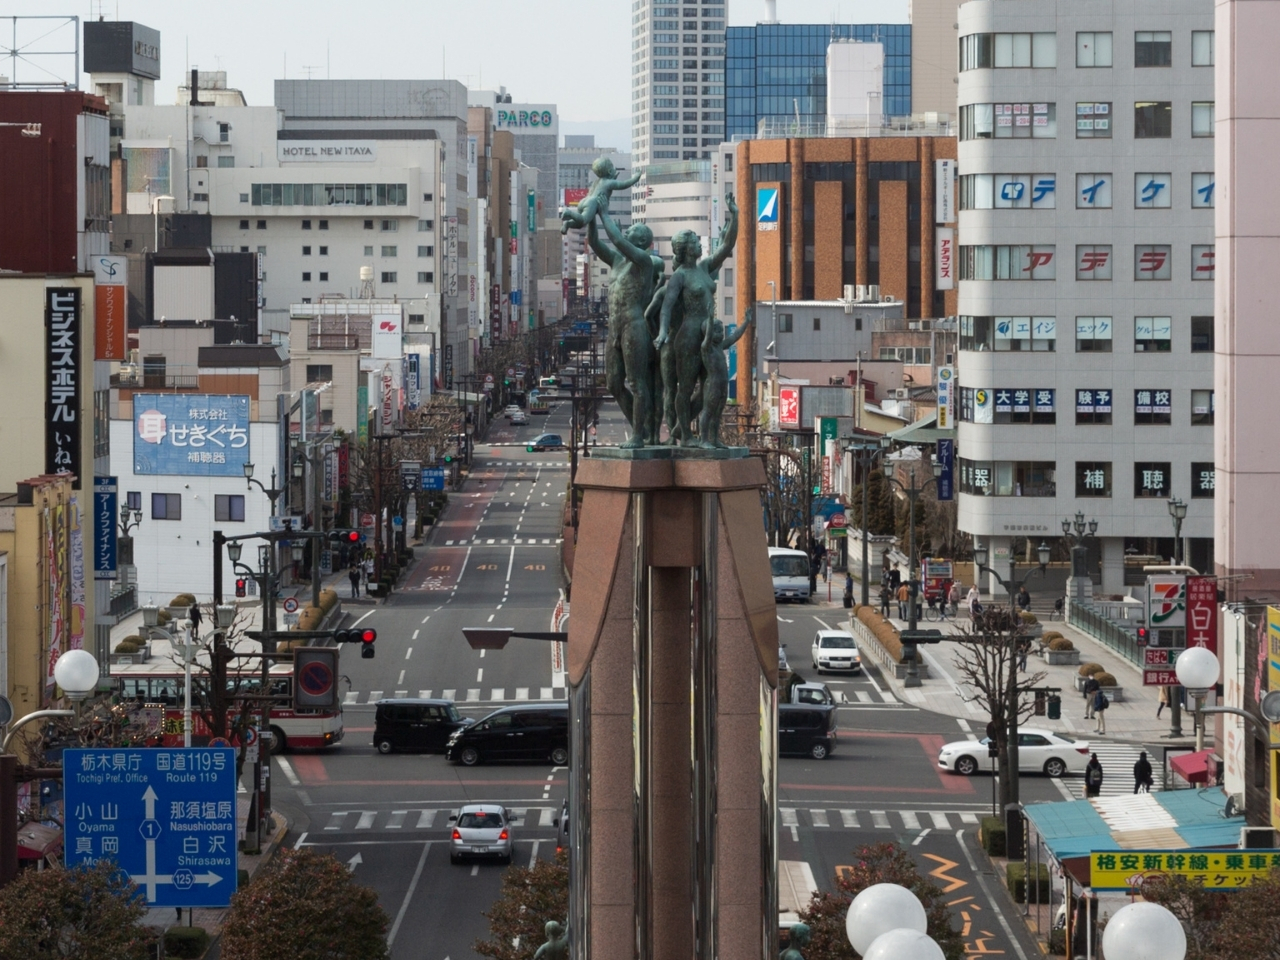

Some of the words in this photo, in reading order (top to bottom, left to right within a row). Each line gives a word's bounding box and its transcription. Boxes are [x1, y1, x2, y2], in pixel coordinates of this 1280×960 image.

[497, 109, 552, 128] PARCO
[282, 146, 318, 157] HOTEL
[321, 146, 343, 156] NEW
[344, 145, 373, 156] ITAYA
[941, 239, 950, 278] アデランス
[51, 292, 75, 423] ビジネスホテル
[189, 409, 227, 420] 株式会社
[169, 423, 248, 448] せきぐち
[187, 451, 226, 464] 補聴器
[100, 494, 111, 570] アークファイナンス
[1146, 651, 1168, 664] たばこ
[81, 753, 143, 771] 栃木県庁
[156, 753, 227, 771] 国道119号
[76, 773, 103, 785] Tochigi
[106, 773, 123, 783] Pref.
[125, 773, 148, 783] Office
[166, 773, 196, 782] Route
[200, 773, 218, 782] 119
[75, 802, 118, 820] 小山
[170, 801, 233, 819] 那須塩原
[78, 822, 115, 833] Oyama
[170, 822, 233, 831] Nasushiobara
[75, 837, 119, 854] 真岡
[183, 836, 227, 853] 白沢
[177, 855, 231, 866] Shirasawa
[176, 874, 191, 885] 125
